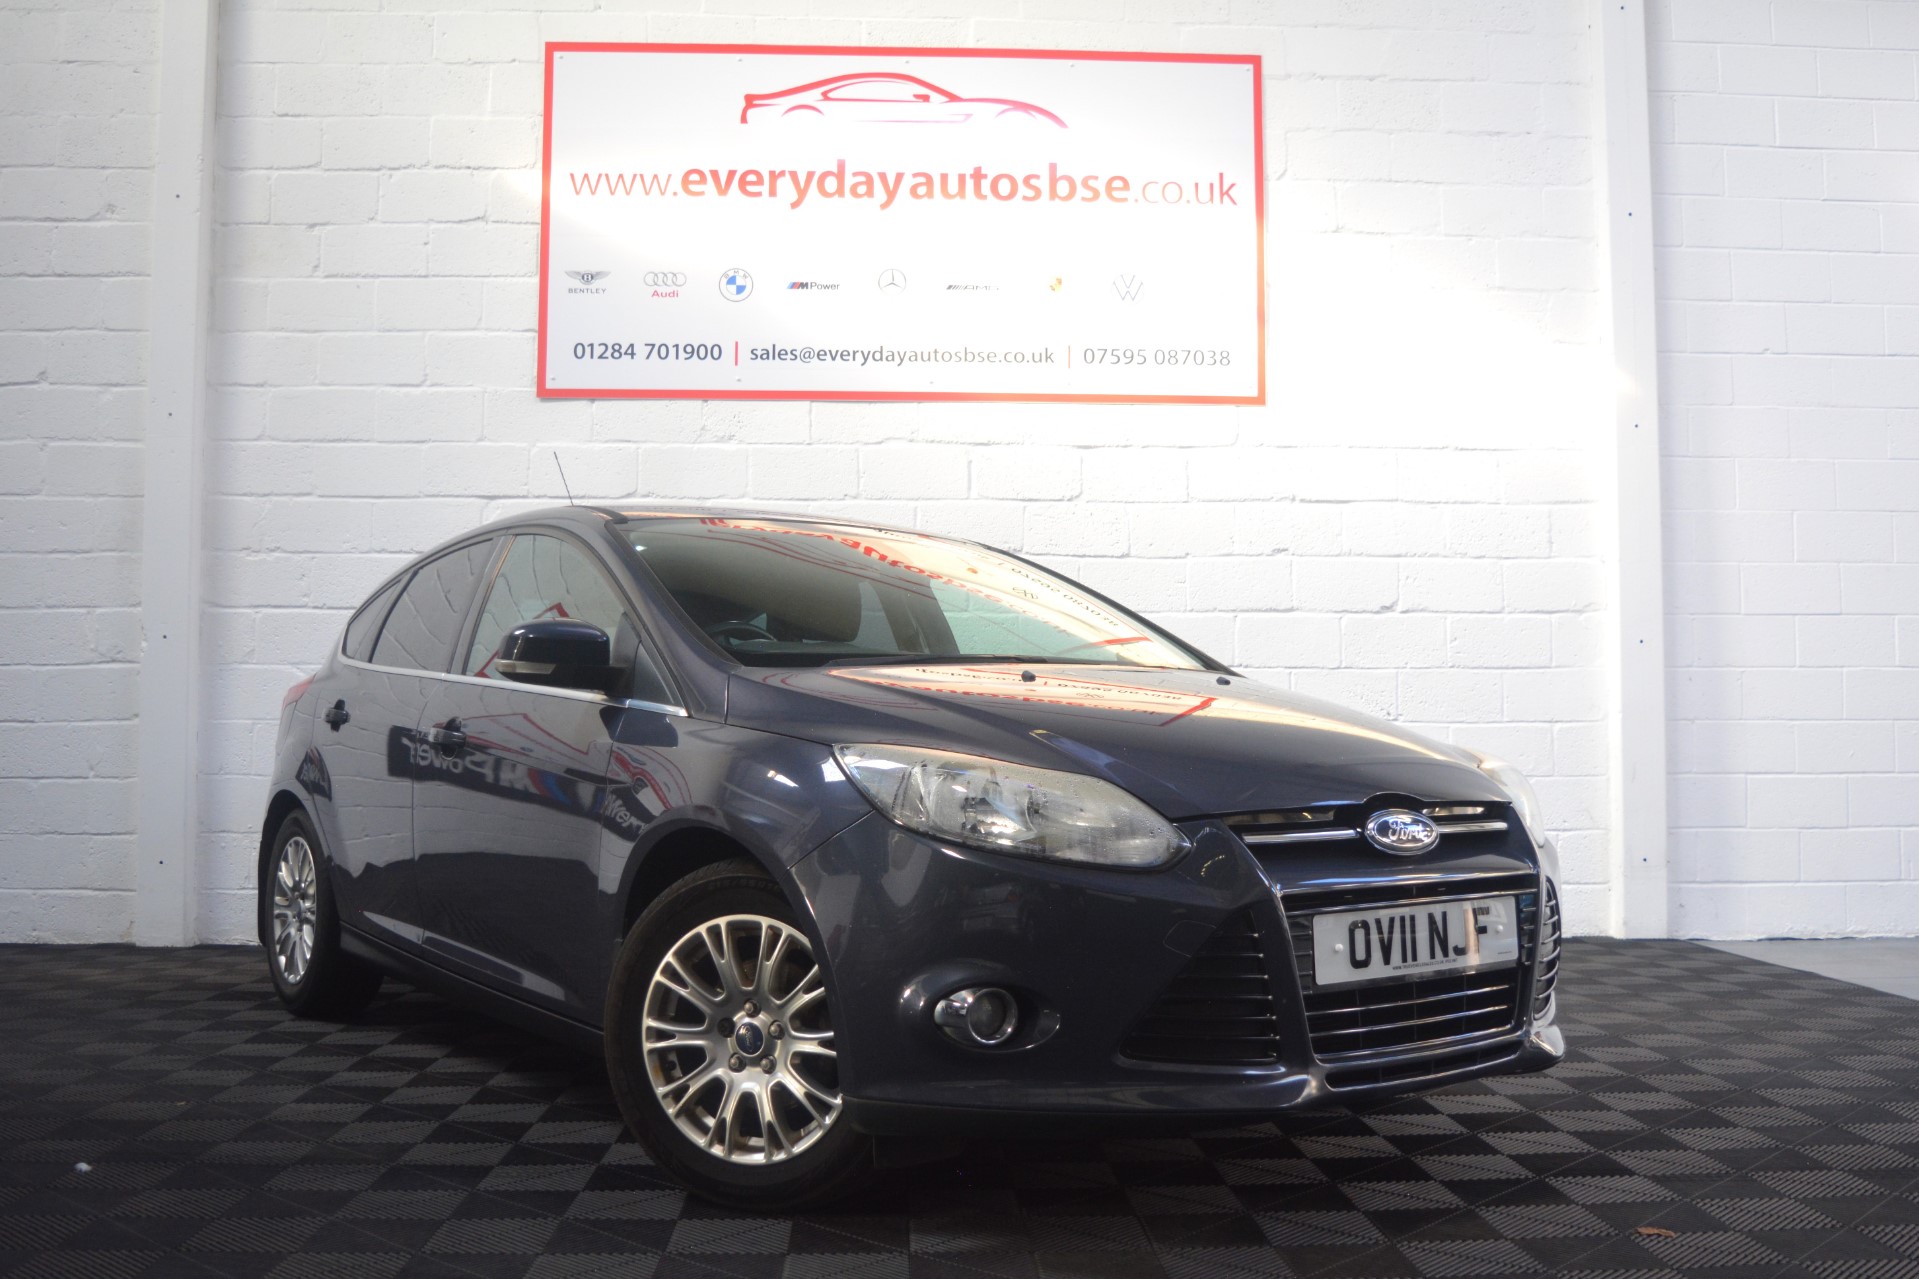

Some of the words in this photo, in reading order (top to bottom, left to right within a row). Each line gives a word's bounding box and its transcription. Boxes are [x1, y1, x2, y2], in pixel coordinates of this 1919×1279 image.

[569, 158, 1238, 211] www.everydayautosbse.co.uk
[651, 289, 679, 298] Audi
[573, 343, 636, 361] 01284
[644, 343, 722, 361] 701900
[750, 344, 1054, 367] sales@everydayautosbse.co.uk
[1083, 348, 1148, 365] 07595
[1154, 350, 1231, 366] 087038
[1388, 817, 1432, 841] Ford
